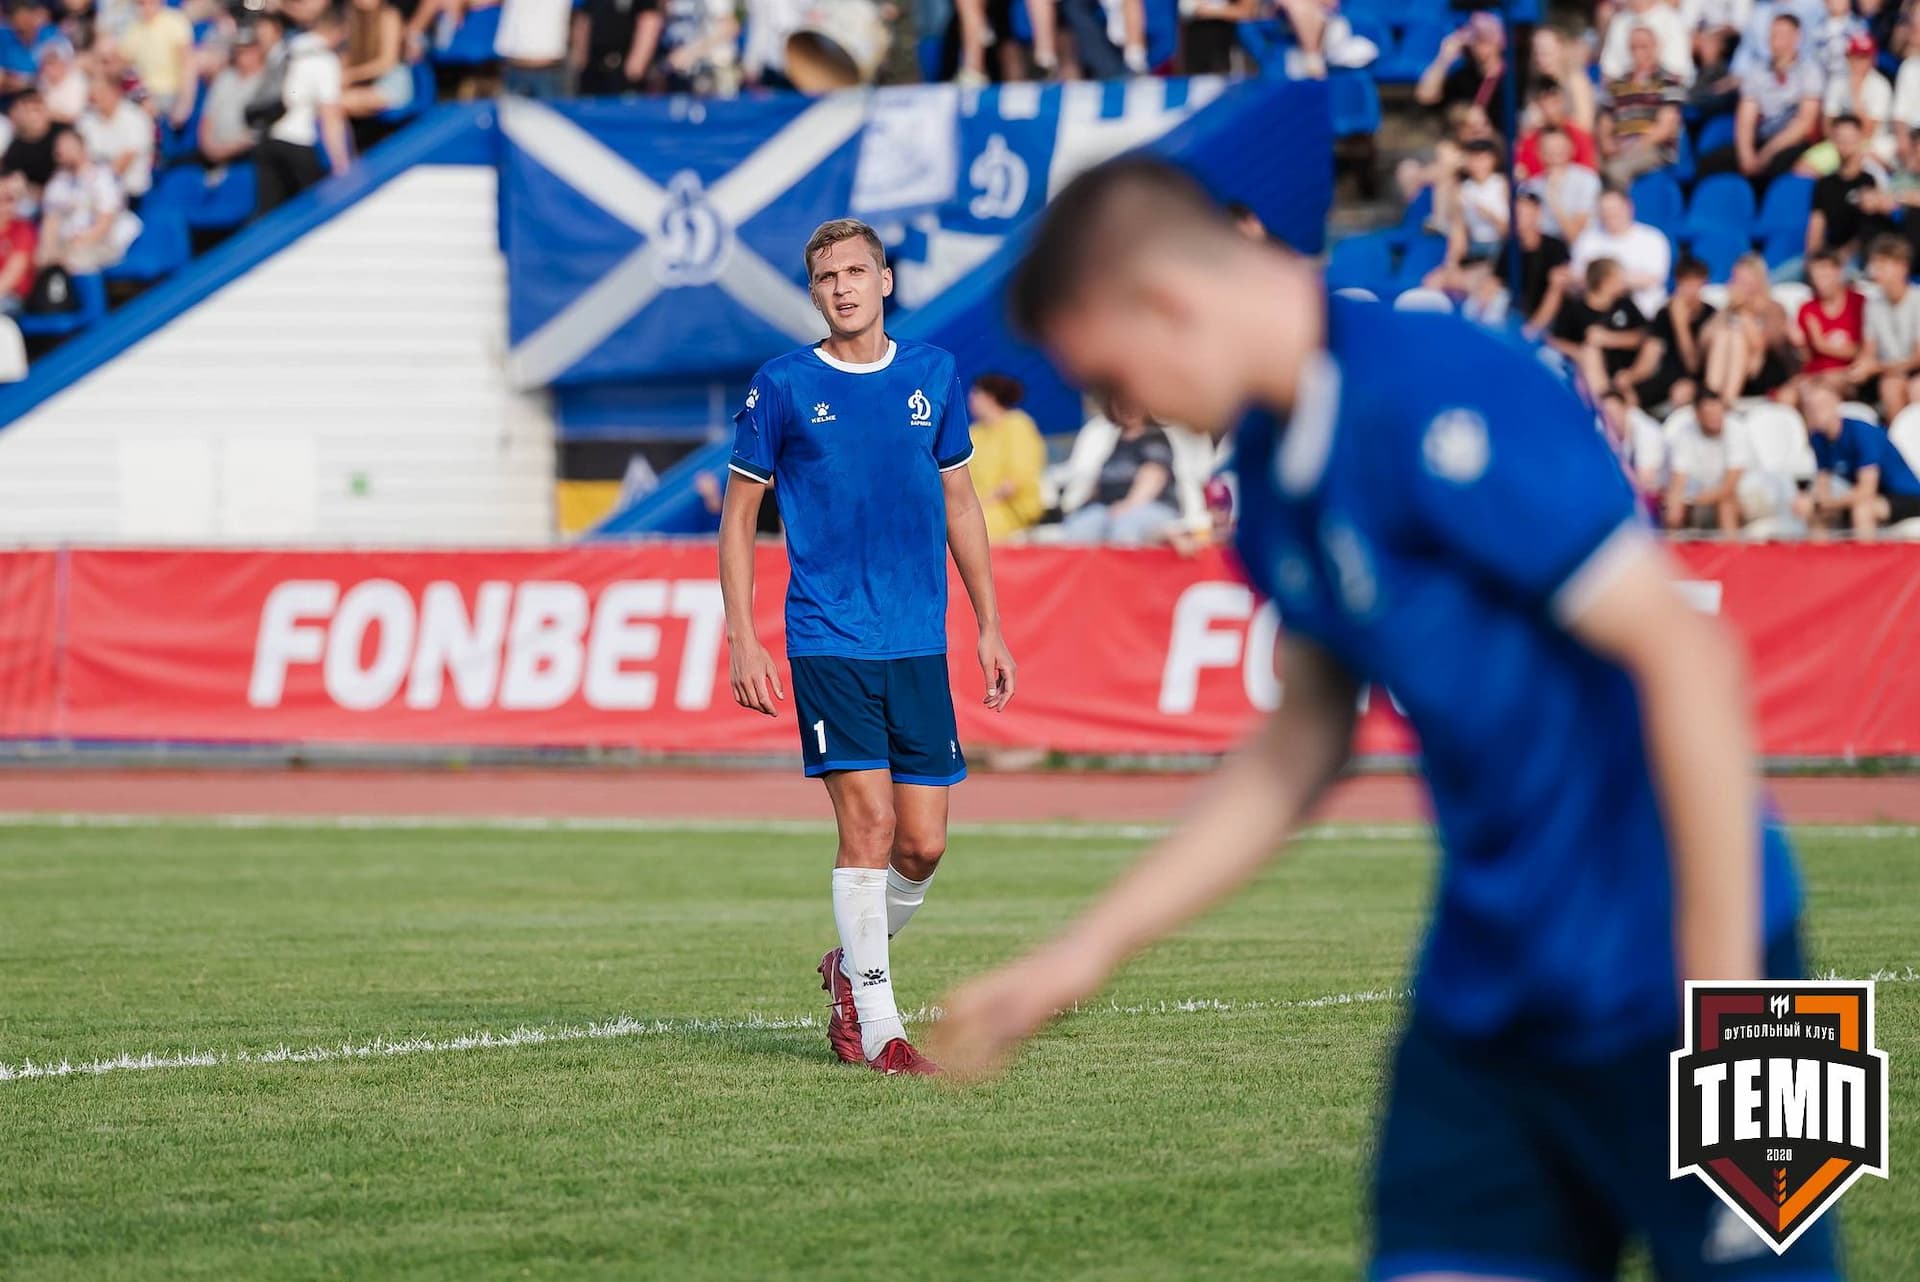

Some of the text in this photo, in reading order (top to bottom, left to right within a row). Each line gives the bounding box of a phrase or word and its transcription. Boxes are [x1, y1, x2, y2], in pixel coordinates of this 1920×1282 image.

[811, 414, 837, 424] KELME
[247, 578, 725, 711] FONBET
[813, 720, 827, 754] 1
